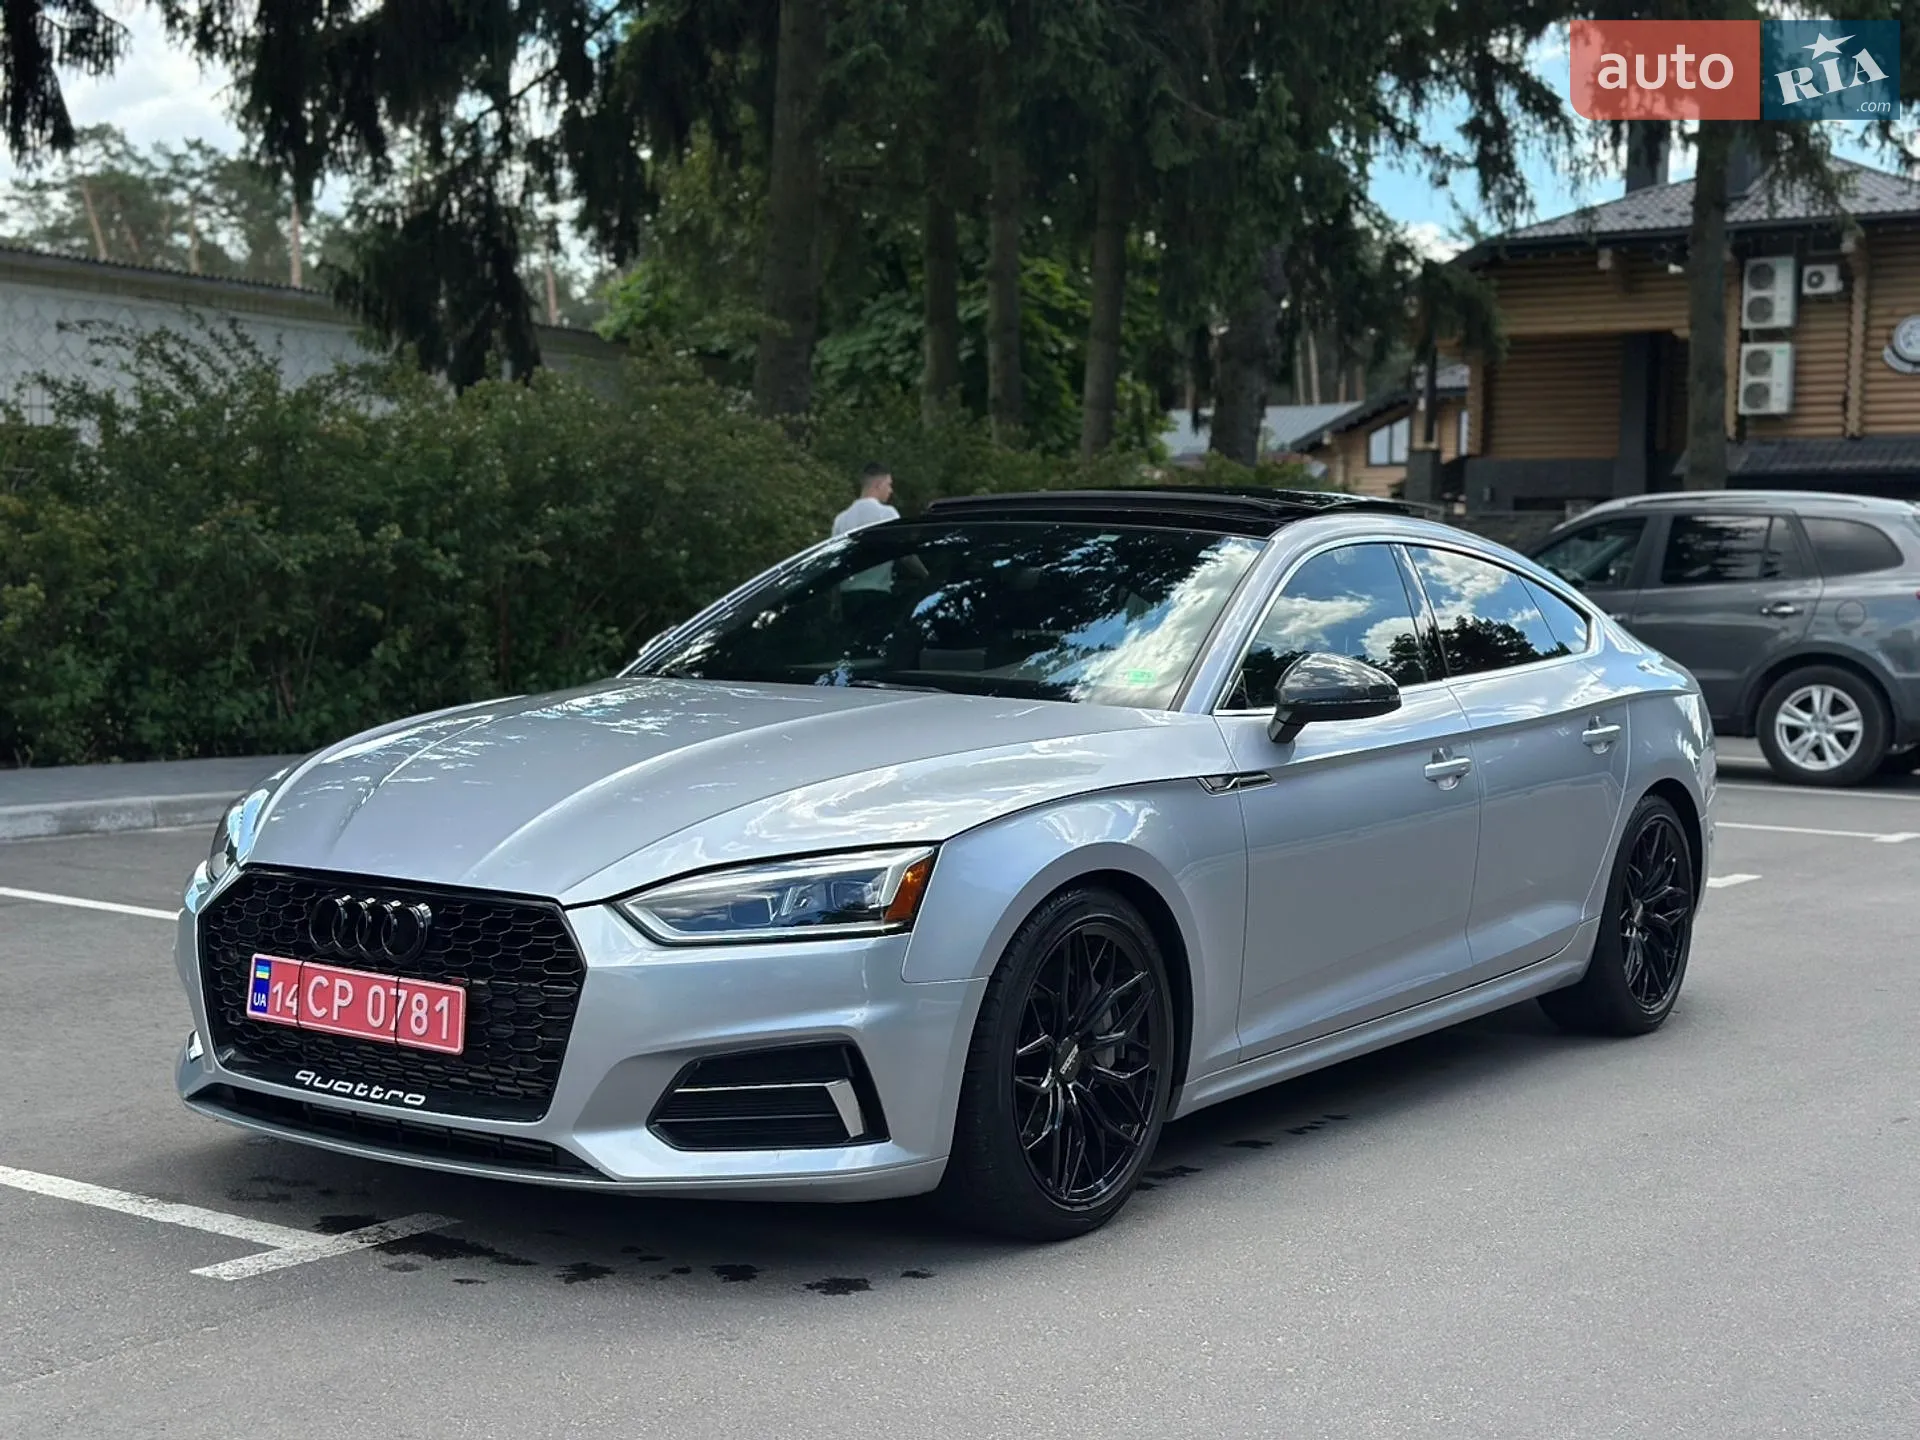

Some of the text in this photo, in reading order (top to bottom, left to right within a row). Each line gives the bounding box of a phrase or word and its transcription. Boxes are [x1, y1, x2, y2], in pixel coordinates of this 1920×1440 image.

[253, 991, 267, 1007] UA
[272, 976, 450, 1039] 14 CP 0781
[295, 1070, 426, 1106] quattro
